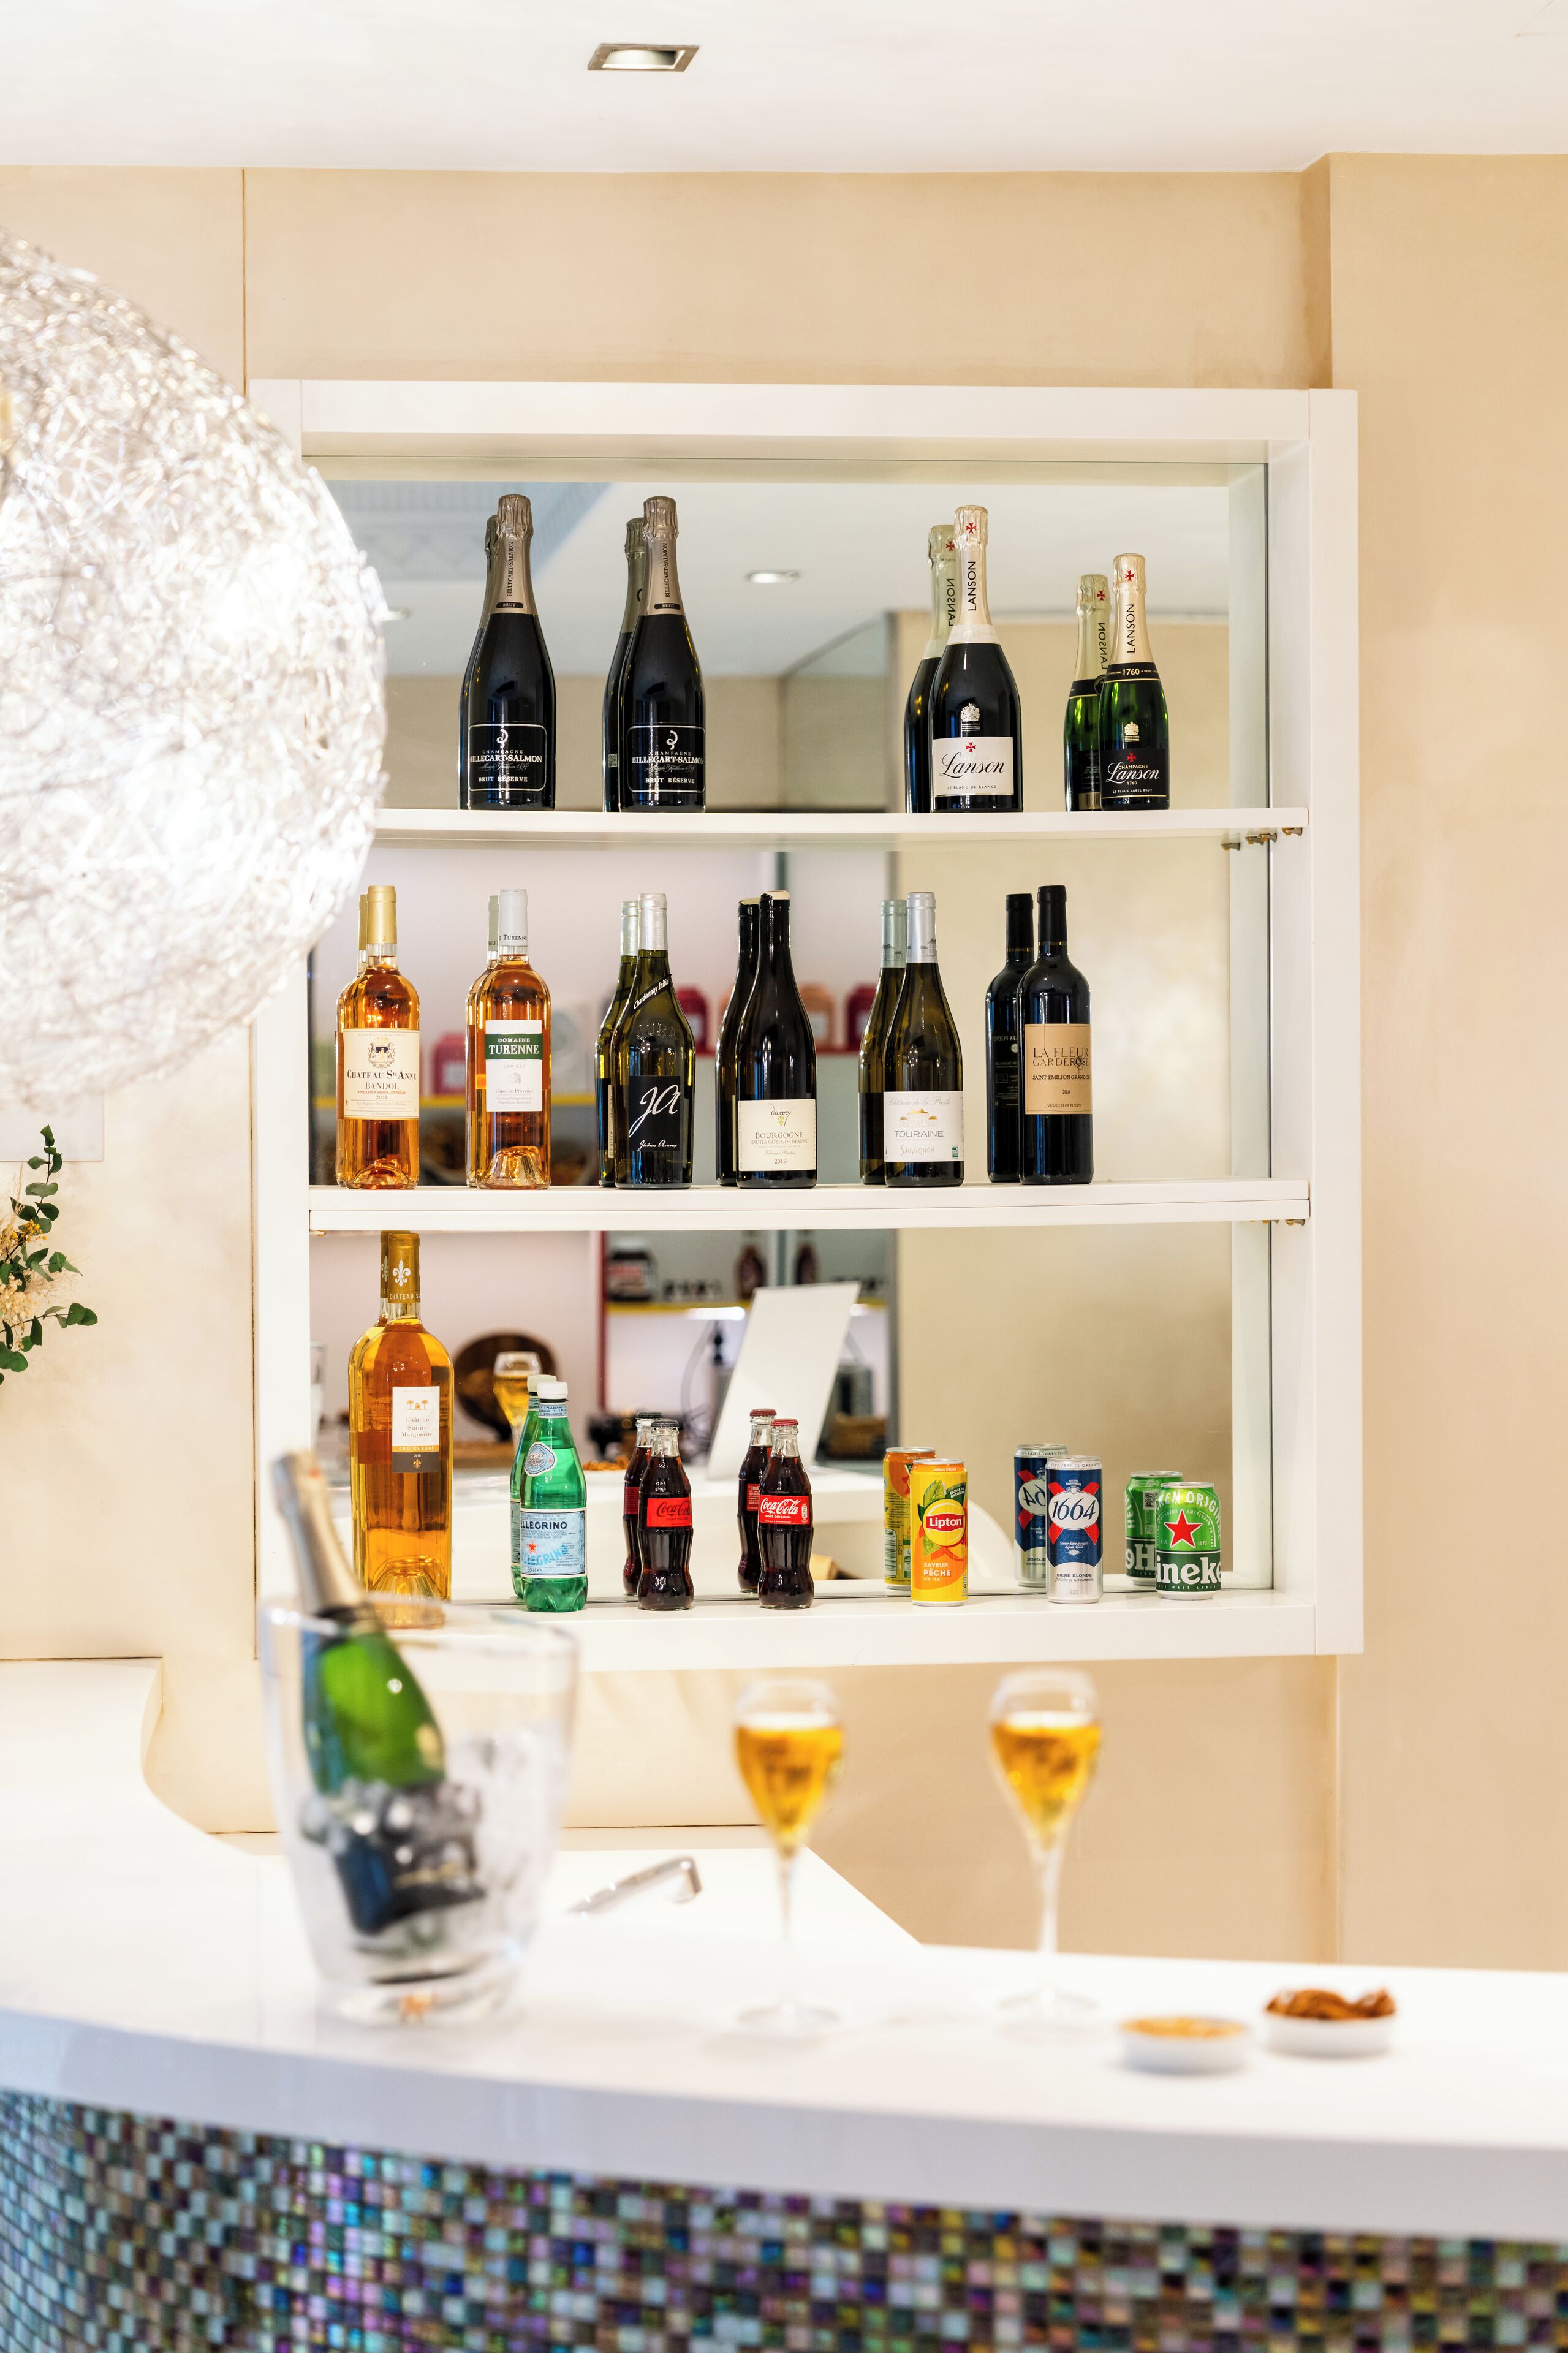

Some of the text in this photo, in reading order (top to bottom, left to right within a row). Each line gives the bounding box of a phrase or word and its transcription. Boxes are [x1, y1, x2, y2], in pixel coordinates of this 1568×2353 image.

[968, 561, 976, 611] LANSON
[1126, 604, 1135, 653] LANSON
[939, 752, 1004, 778] Lanson
[1105, 761, 1159, 784] Lanson
[634, 986, 658, 1009] Chardonnay
[489, 1044, 539, 1054] TURENNE
[1034, 1047, 1089, 1058] LA FLEUR
[1033, 1058, 1089, 1067] GARDEROSE
[365, 1082, 400, 1090] BANDOL
[760, 1498, 801, 1515] Coca-Cola
[1052, 1497, 1096, 1520] 1664
[929, 1518, 961, 1528] Lipton
[1186, 1509, 1211, 1526] AMSTERDAM
[923, 1567, 951, 1576] PÊCHE
